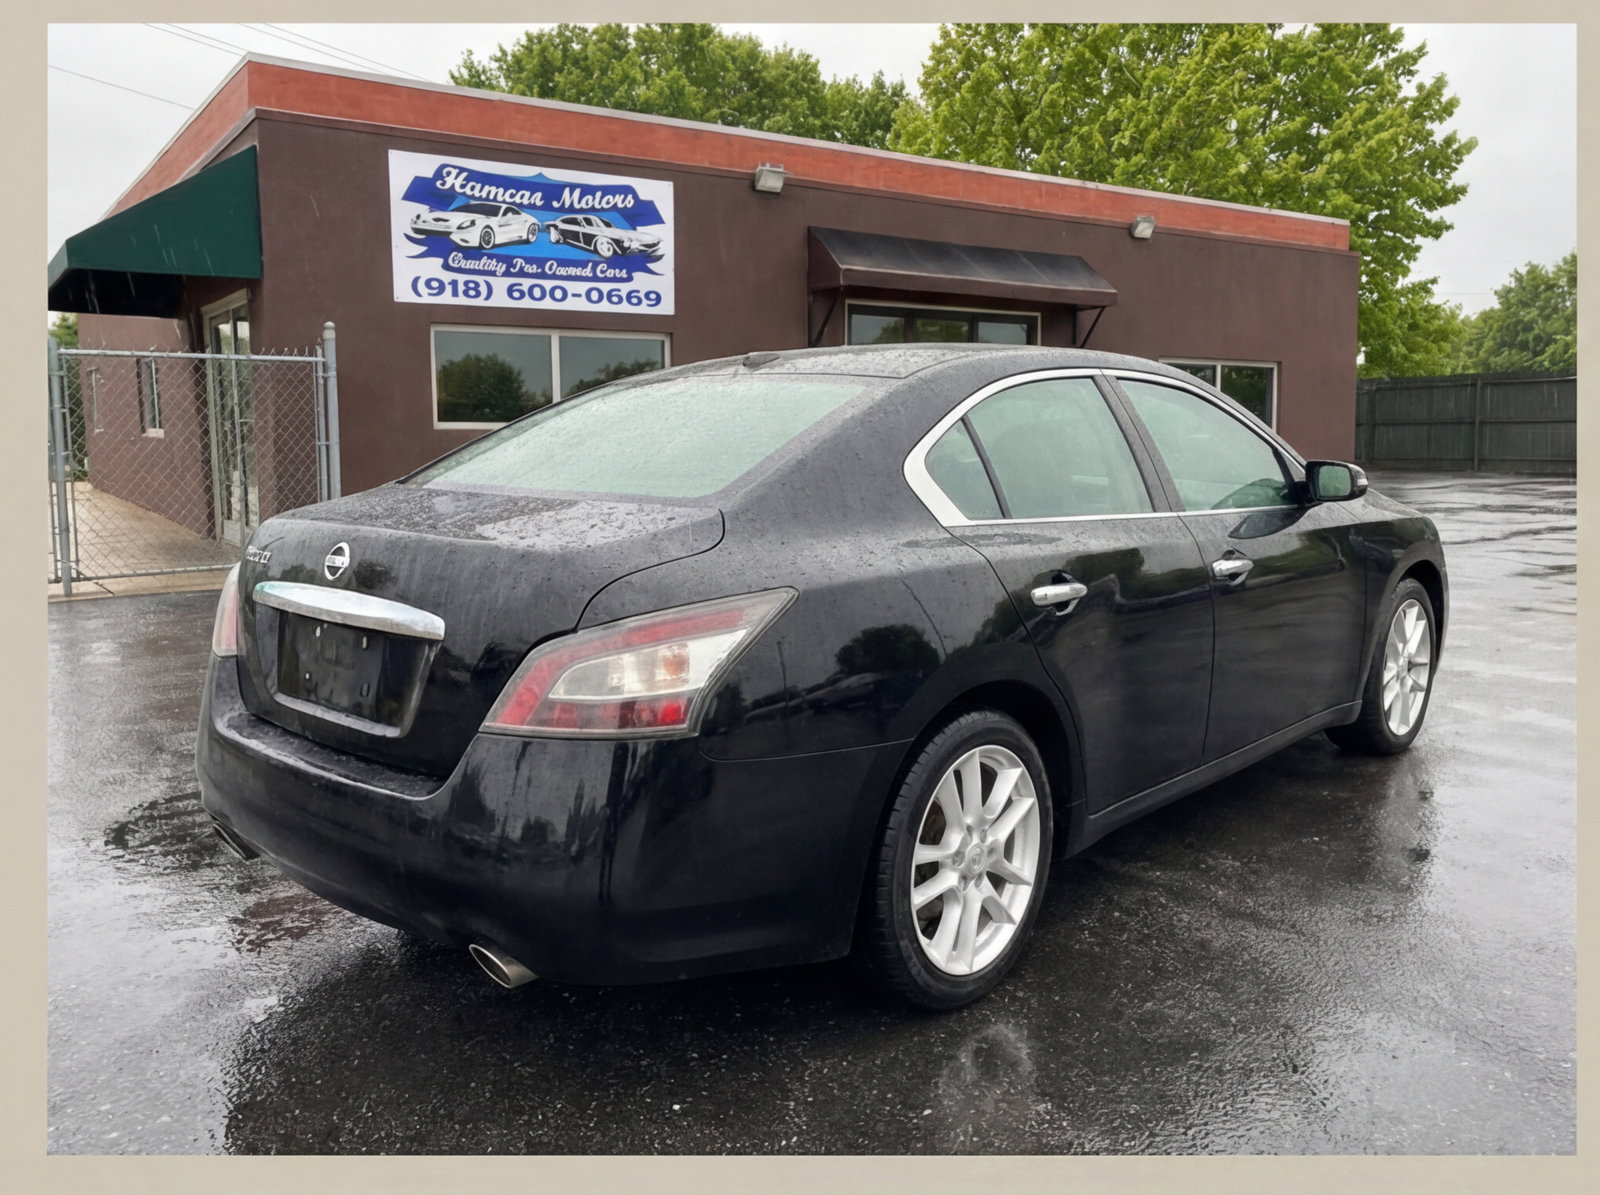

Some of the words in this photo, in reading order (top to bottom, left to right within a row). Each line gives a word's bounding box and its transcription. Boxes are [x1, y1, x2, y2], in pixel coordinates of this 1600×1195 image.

[552, 187, 635, 209] Motors
[447, 251, 507, 276] Quality
[596, 263, 628, 279] Cars
[411, 276, 494, 301] (918)
[506, 282, 663, 308] 600-0669
